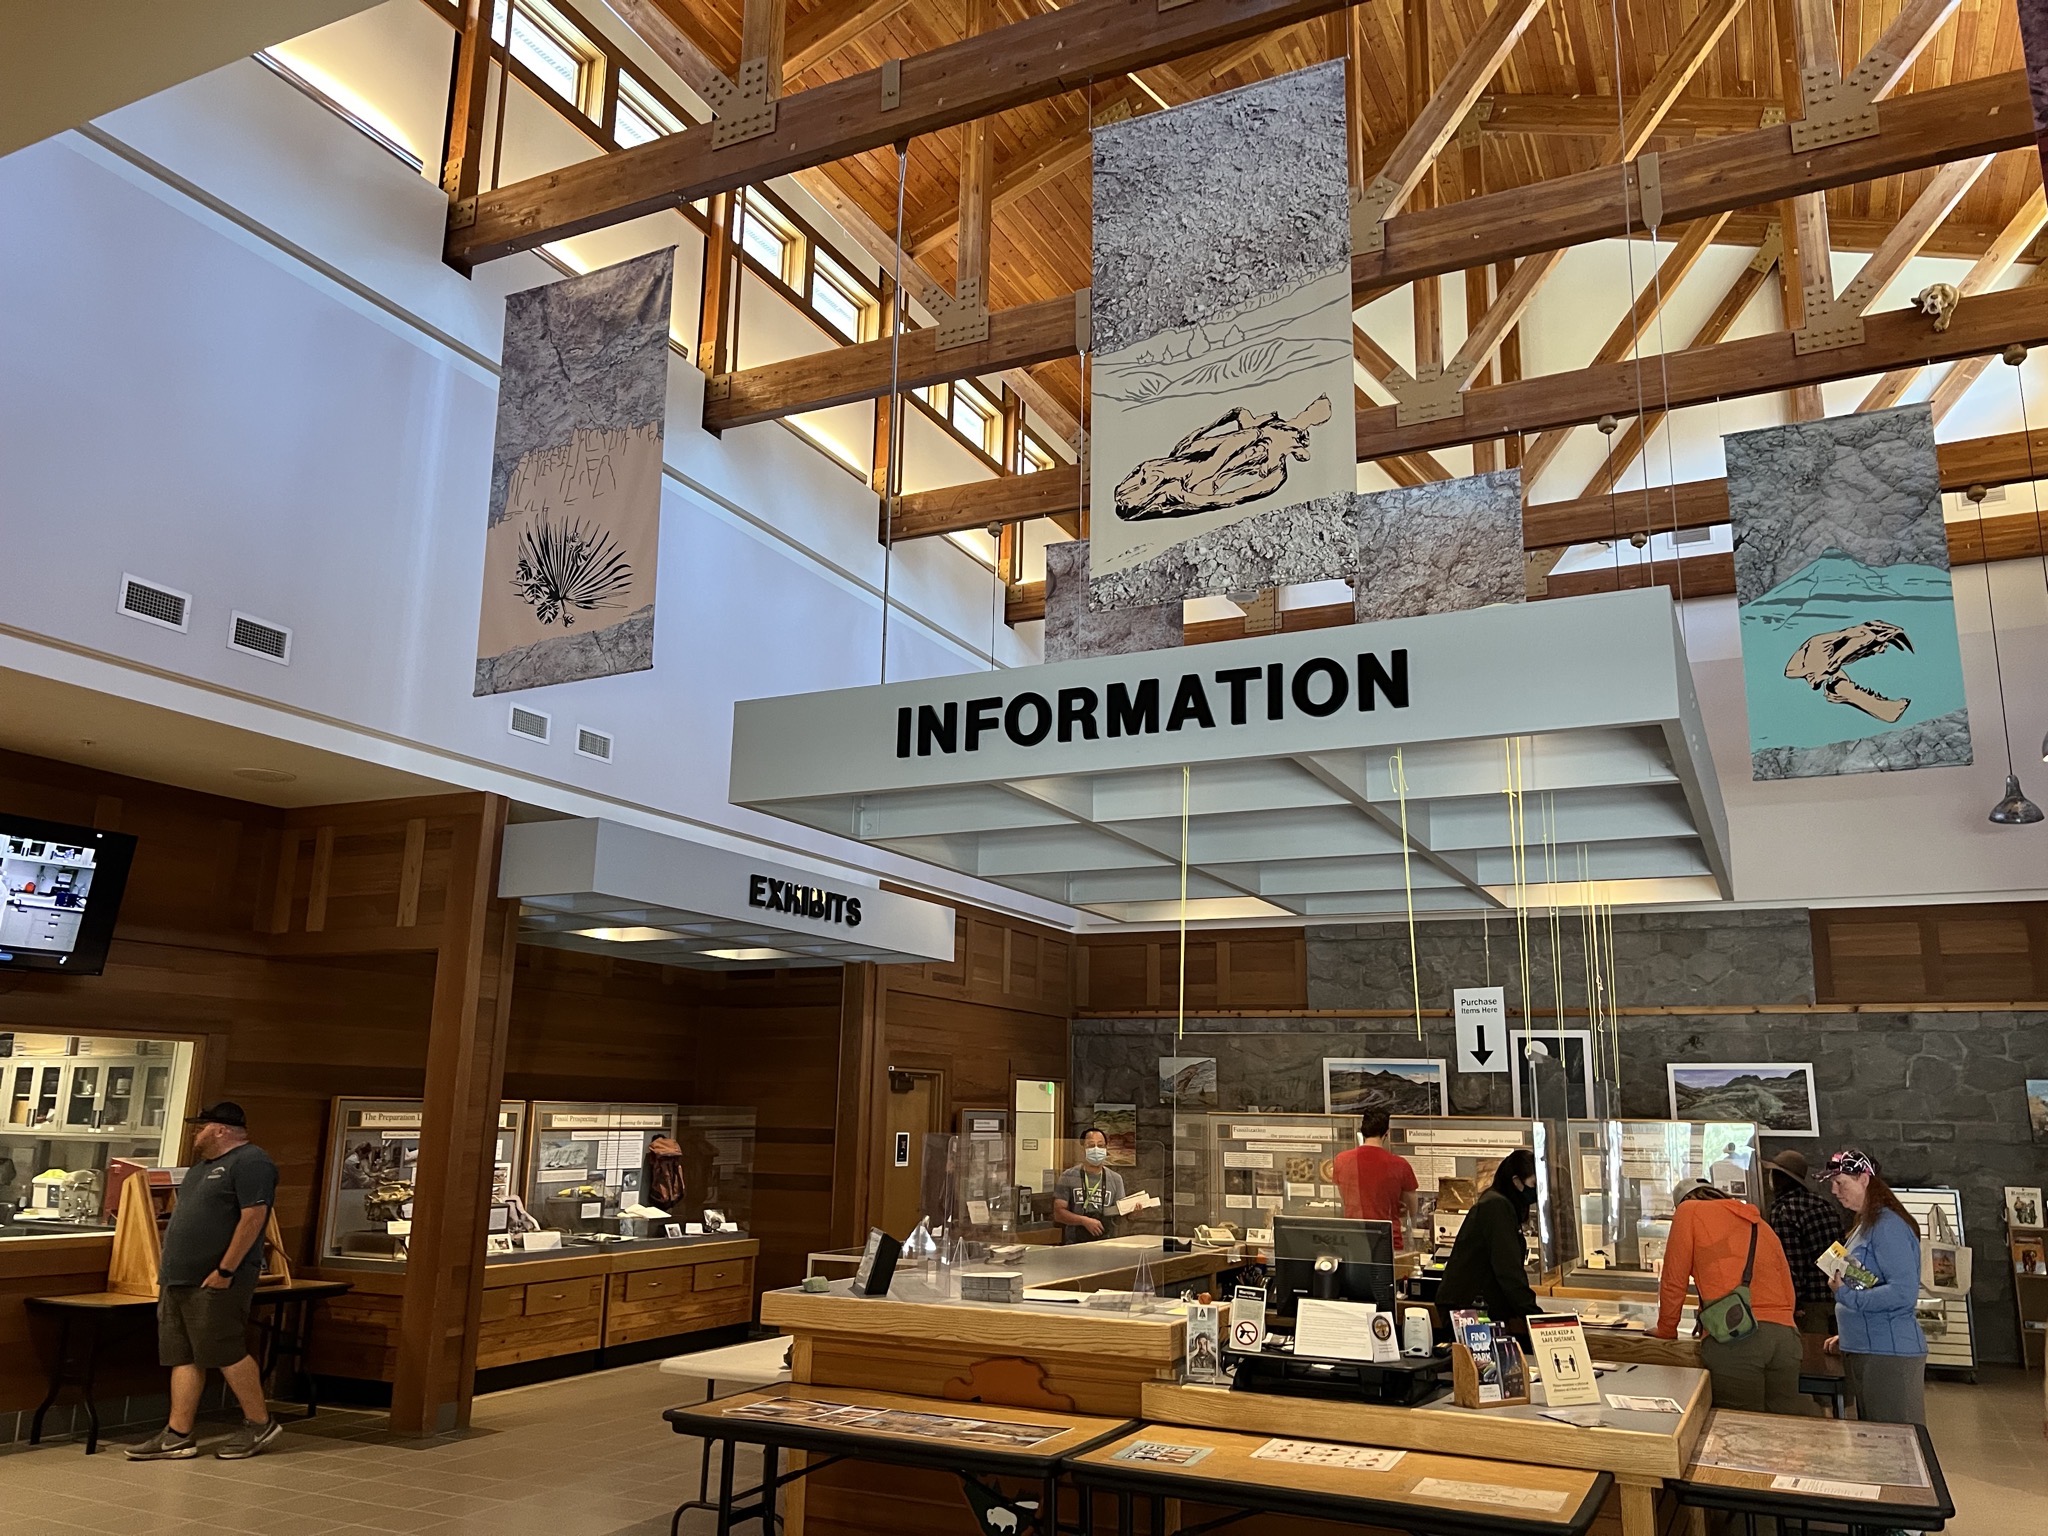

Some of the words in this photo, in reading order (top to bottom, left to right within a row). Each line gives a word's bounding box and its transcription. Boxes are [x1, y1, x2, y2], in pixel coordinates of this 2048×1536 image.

[896, 648, 1410, 758] INFORMATION
[749, 873, 862, 926] EXHIBITS
[1461, 998, 1498, 1006] Purchase
[364, 1112, 376, 1121] The
[378, 1112, 416, 1122] Preparation
[569, 1115, 598, 1124] Prospecting
[1312, 1234, 1349, 1247] DELL
[1459, 1317, 1475, 1326] FIND
[1470, 1332, 1487, 1341] FIND
[1554, 1335, 1576, 1343] DISTANCE
[1470, 1342, 1490, 1351] YOUR
[1473, 1352, 1492, 1361] PARK
